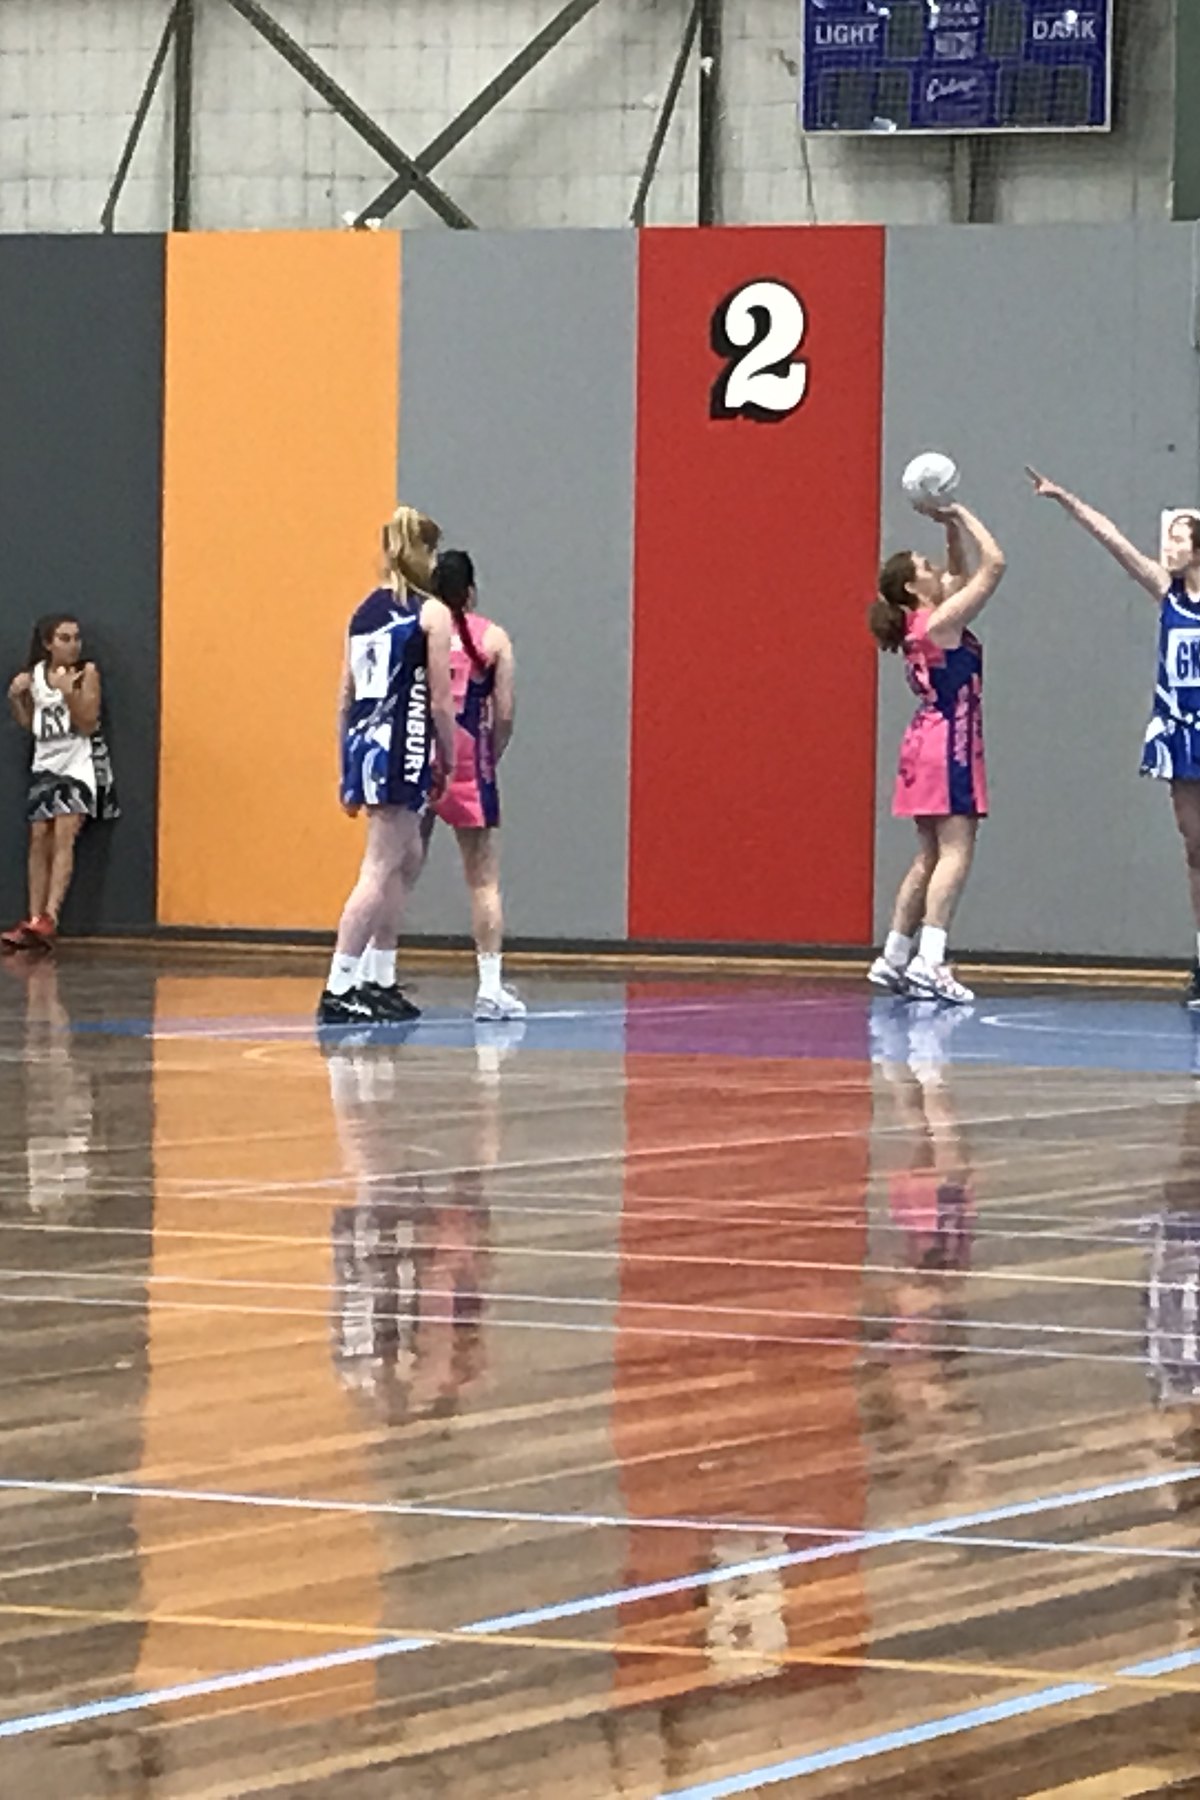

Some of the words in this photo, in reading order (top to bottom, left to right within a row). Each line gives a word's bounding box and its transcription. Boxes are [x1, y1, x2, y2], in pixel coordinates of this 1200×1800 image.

[815, 22, 879, 46] LIGHT
[709, 276, 809, 423] 2
[403, 665, 427, 785] SUNBURY
